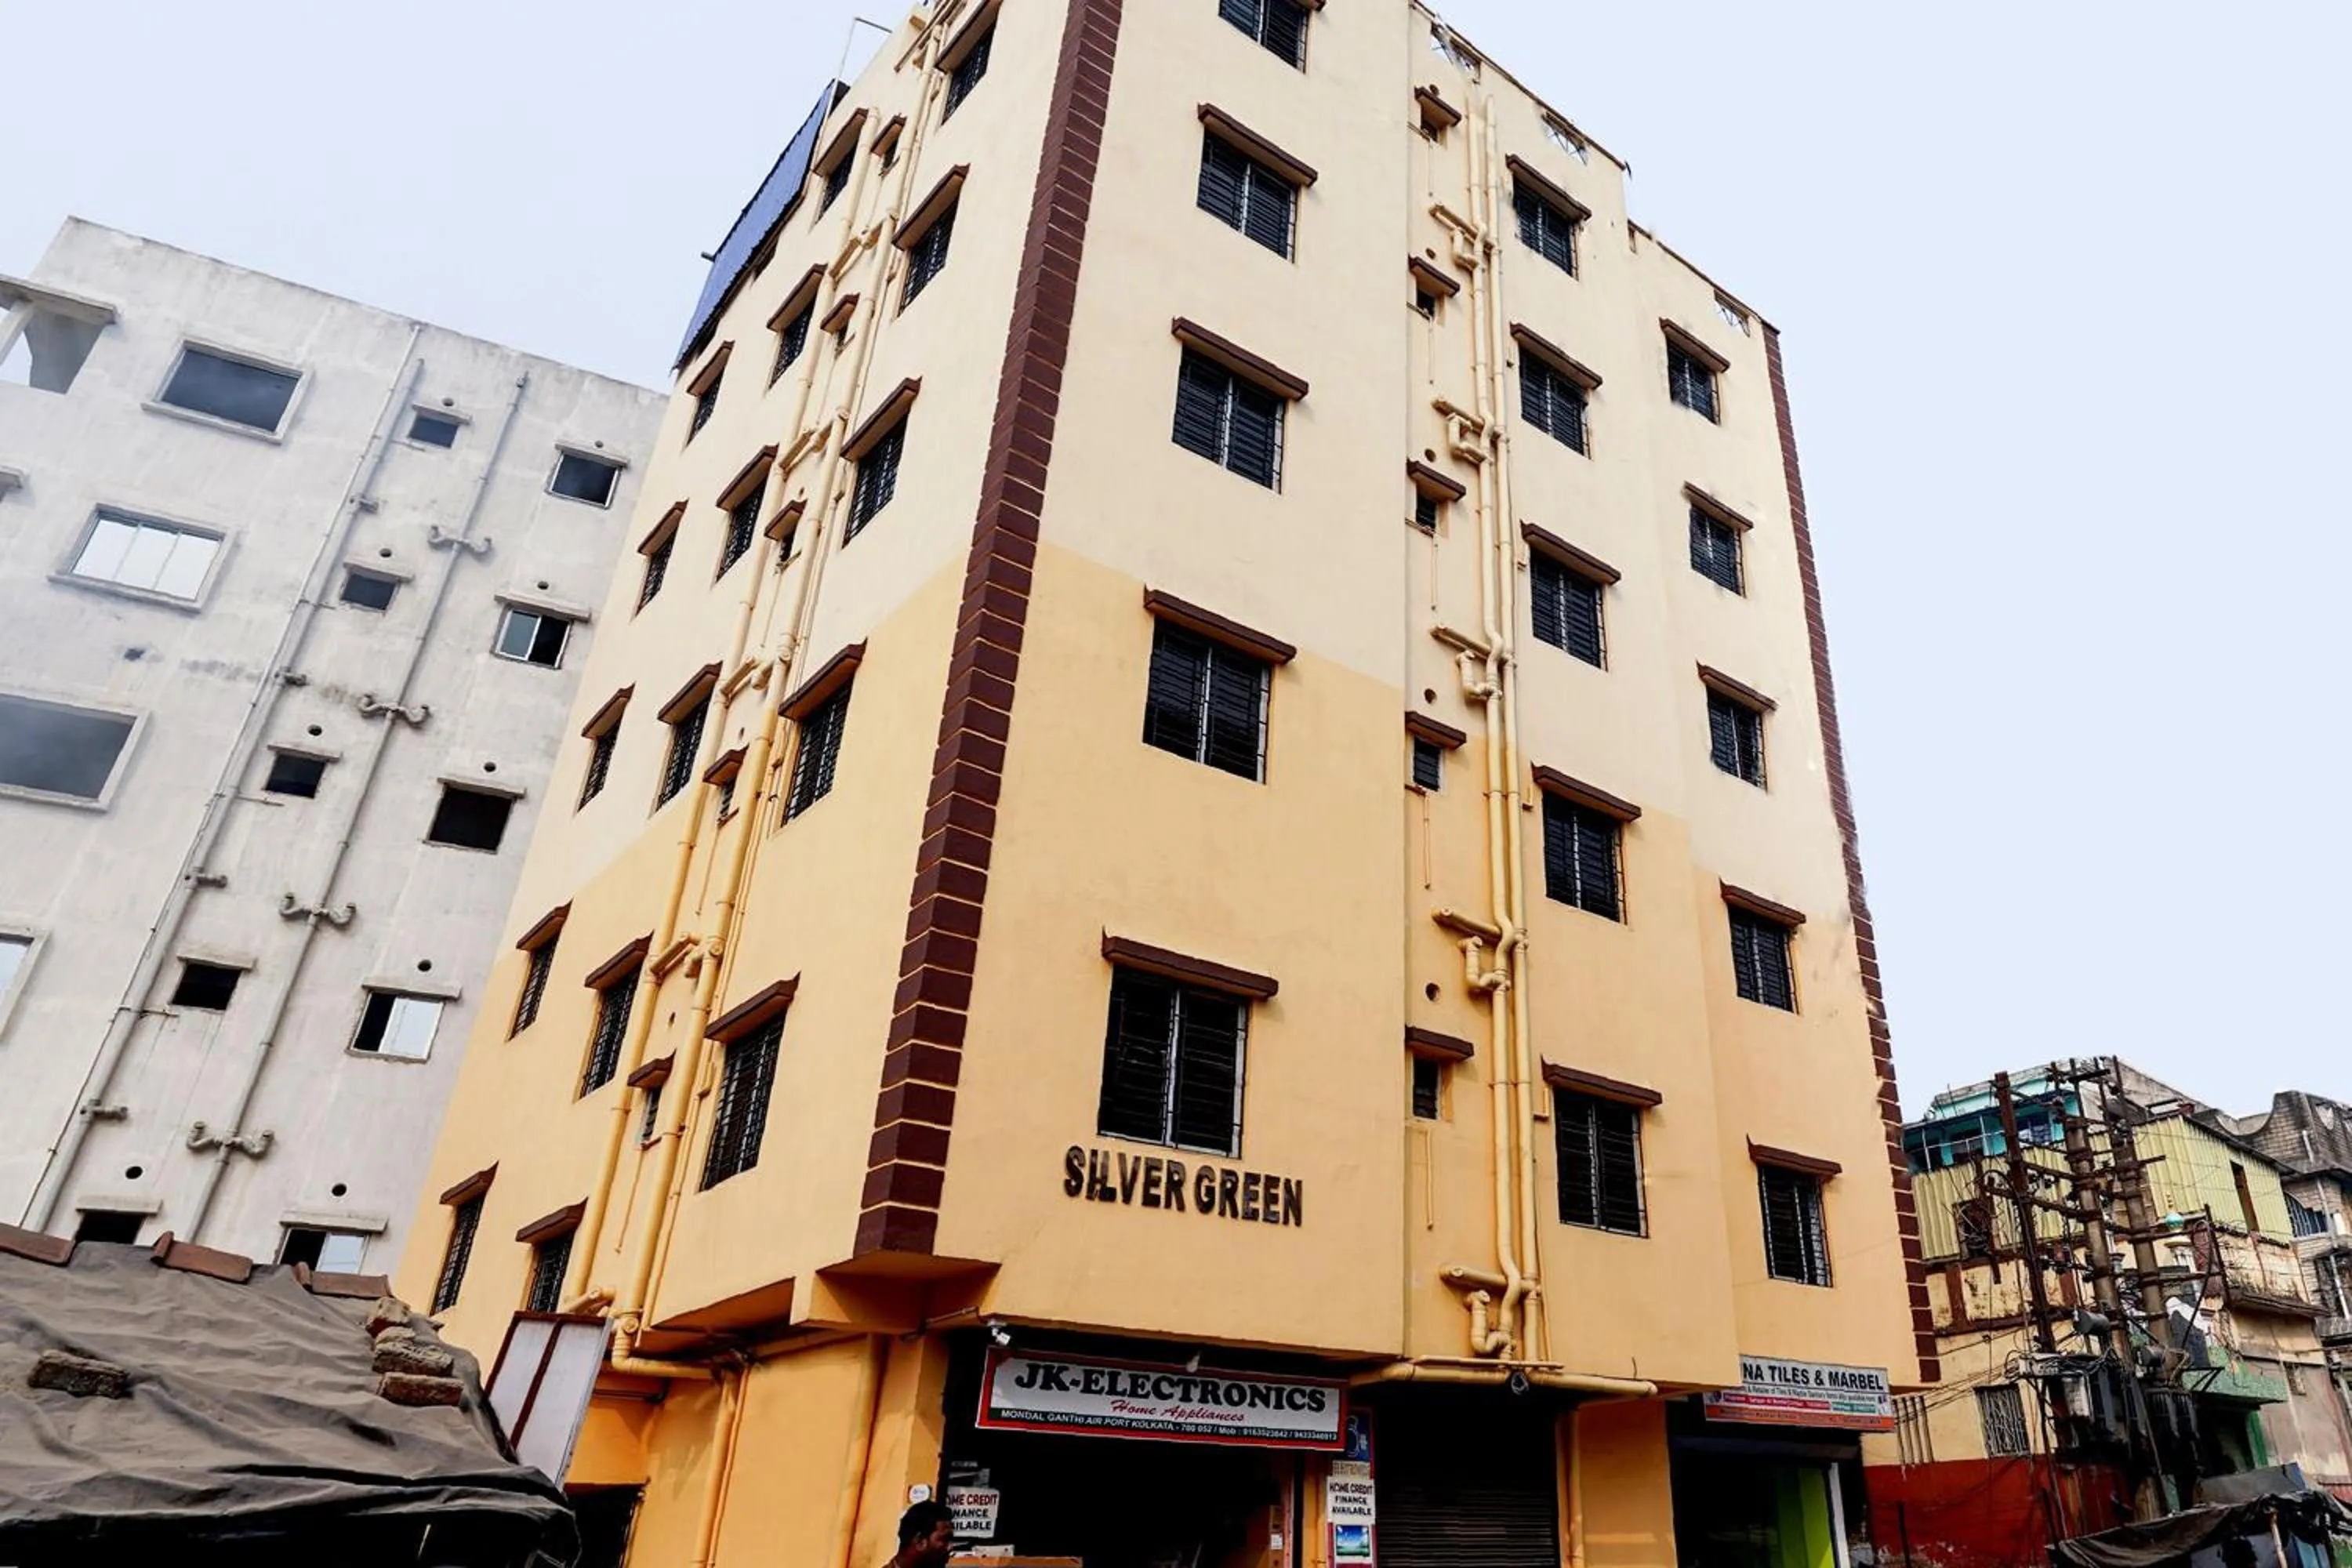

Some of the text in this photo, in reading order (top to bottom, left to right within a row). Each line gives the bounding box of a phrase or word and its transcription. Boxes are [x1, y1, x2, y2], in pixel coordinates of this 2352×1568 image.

[1063, 1145, 1302, 1227] SILVER GREEN
[1768, 1365, 1809, 1385] TILES
[1814, 1372, 1824, 1385] &
[1828, 1370, 1884, 1391] MARBEL
[1014, 1363, 1326, 1413] JK-ELECTRONICS
[1110, 1398, 1244, 1421] Home Appliances
[1001, 1410, 1044, 1421] MONDAL
[1047, 1412, 1084, 1424] GANTHI
[1087, 1416, 1102, 1425] AIR
[1104, 1417, 1131, 1427] PORT
[1131, 1420, 1174, 1431] KOLKATA
[1330, 1483, 1372, 1494] HOME CREDIT
[967, 1494, 998, 1505] CREDIT
[1335, 1495, 1367, 1505] FINANCE
[953, 1508, 989, 1518] NANCE
[1332, 1506, 1371, 1515] AVAILABLE
[954, 1521, 992, 1530] ILABLE
